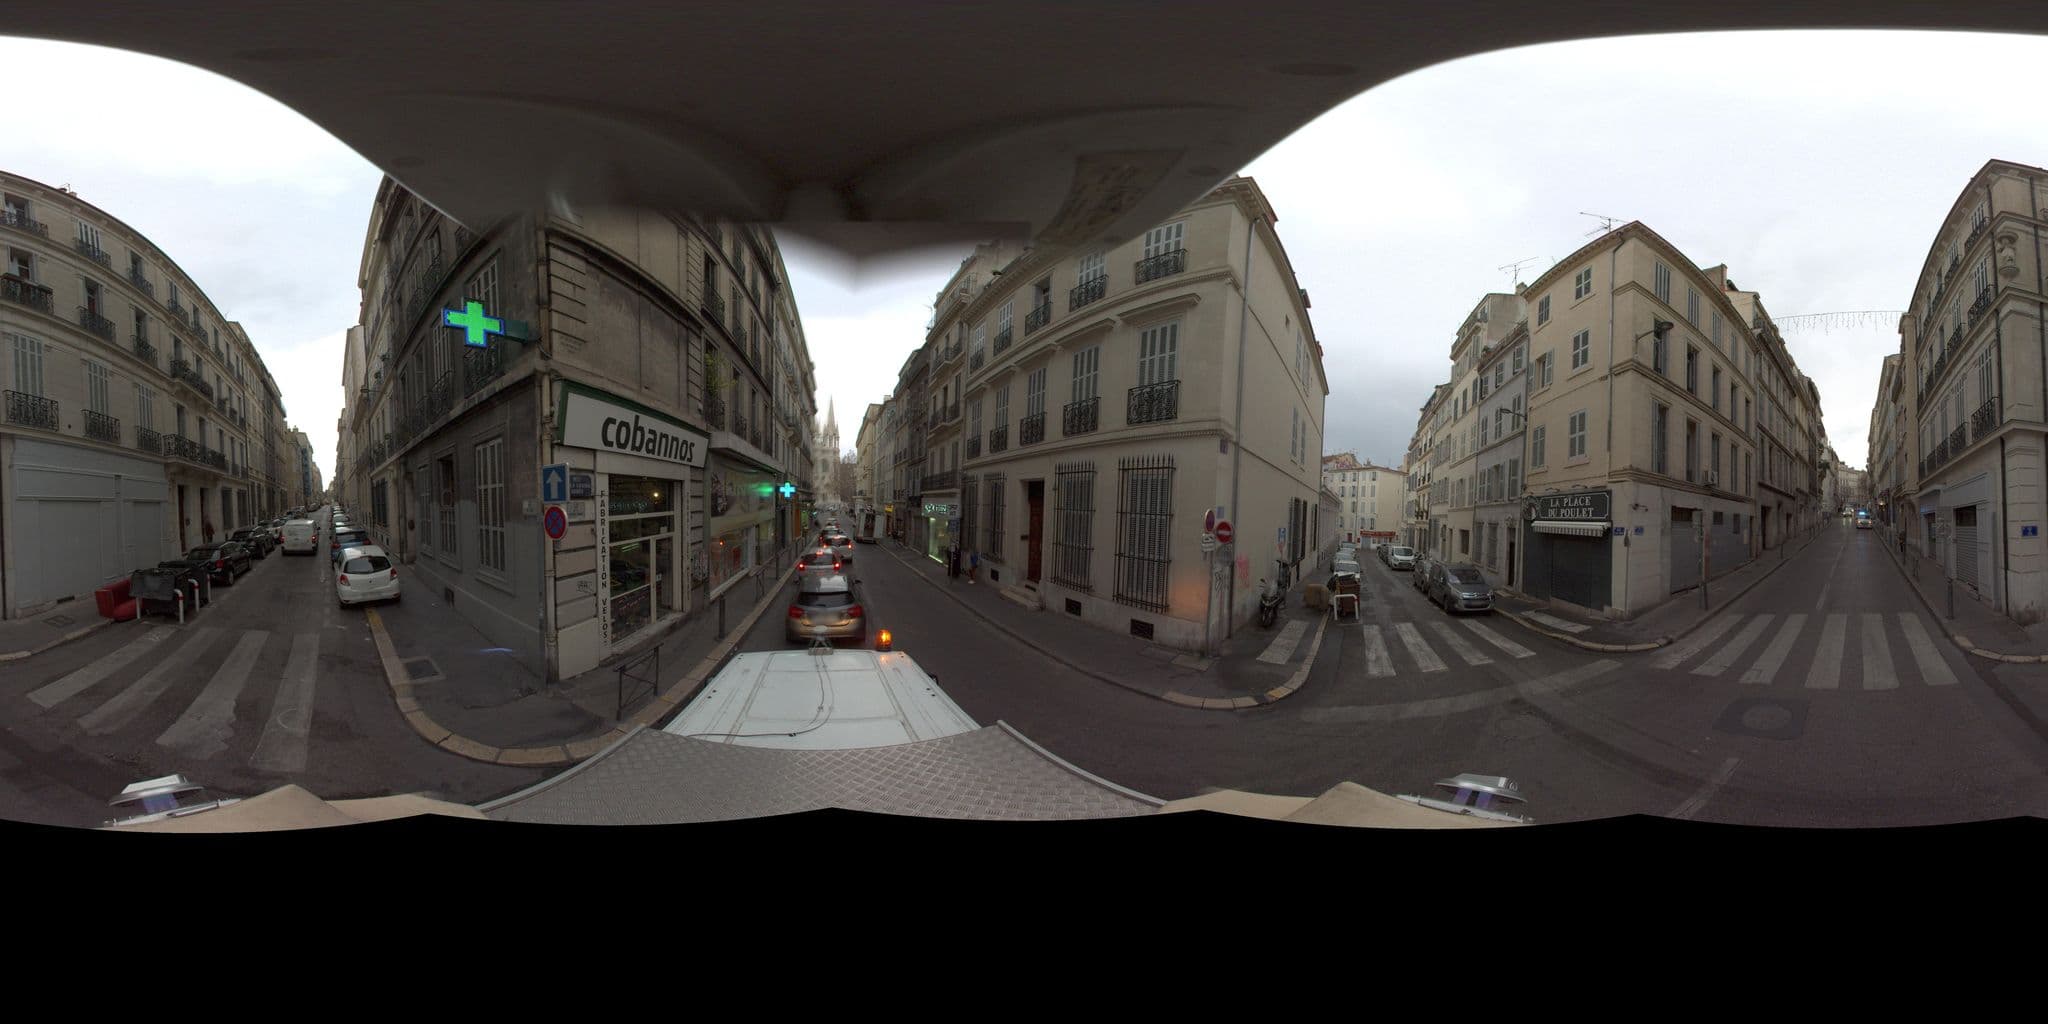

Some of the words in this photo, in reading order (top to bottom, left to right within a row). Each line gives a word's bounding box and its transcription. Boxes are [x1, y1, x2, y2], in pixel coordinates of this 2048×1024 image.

[602, 415, 696, 463] cobannos
[1550, 499, 1561, 507] LA
[1563, 496, 1592, 507] PLACE
[1548, 508, 1558, 517] DU
[1560, 507, 1594, 517] POULET
